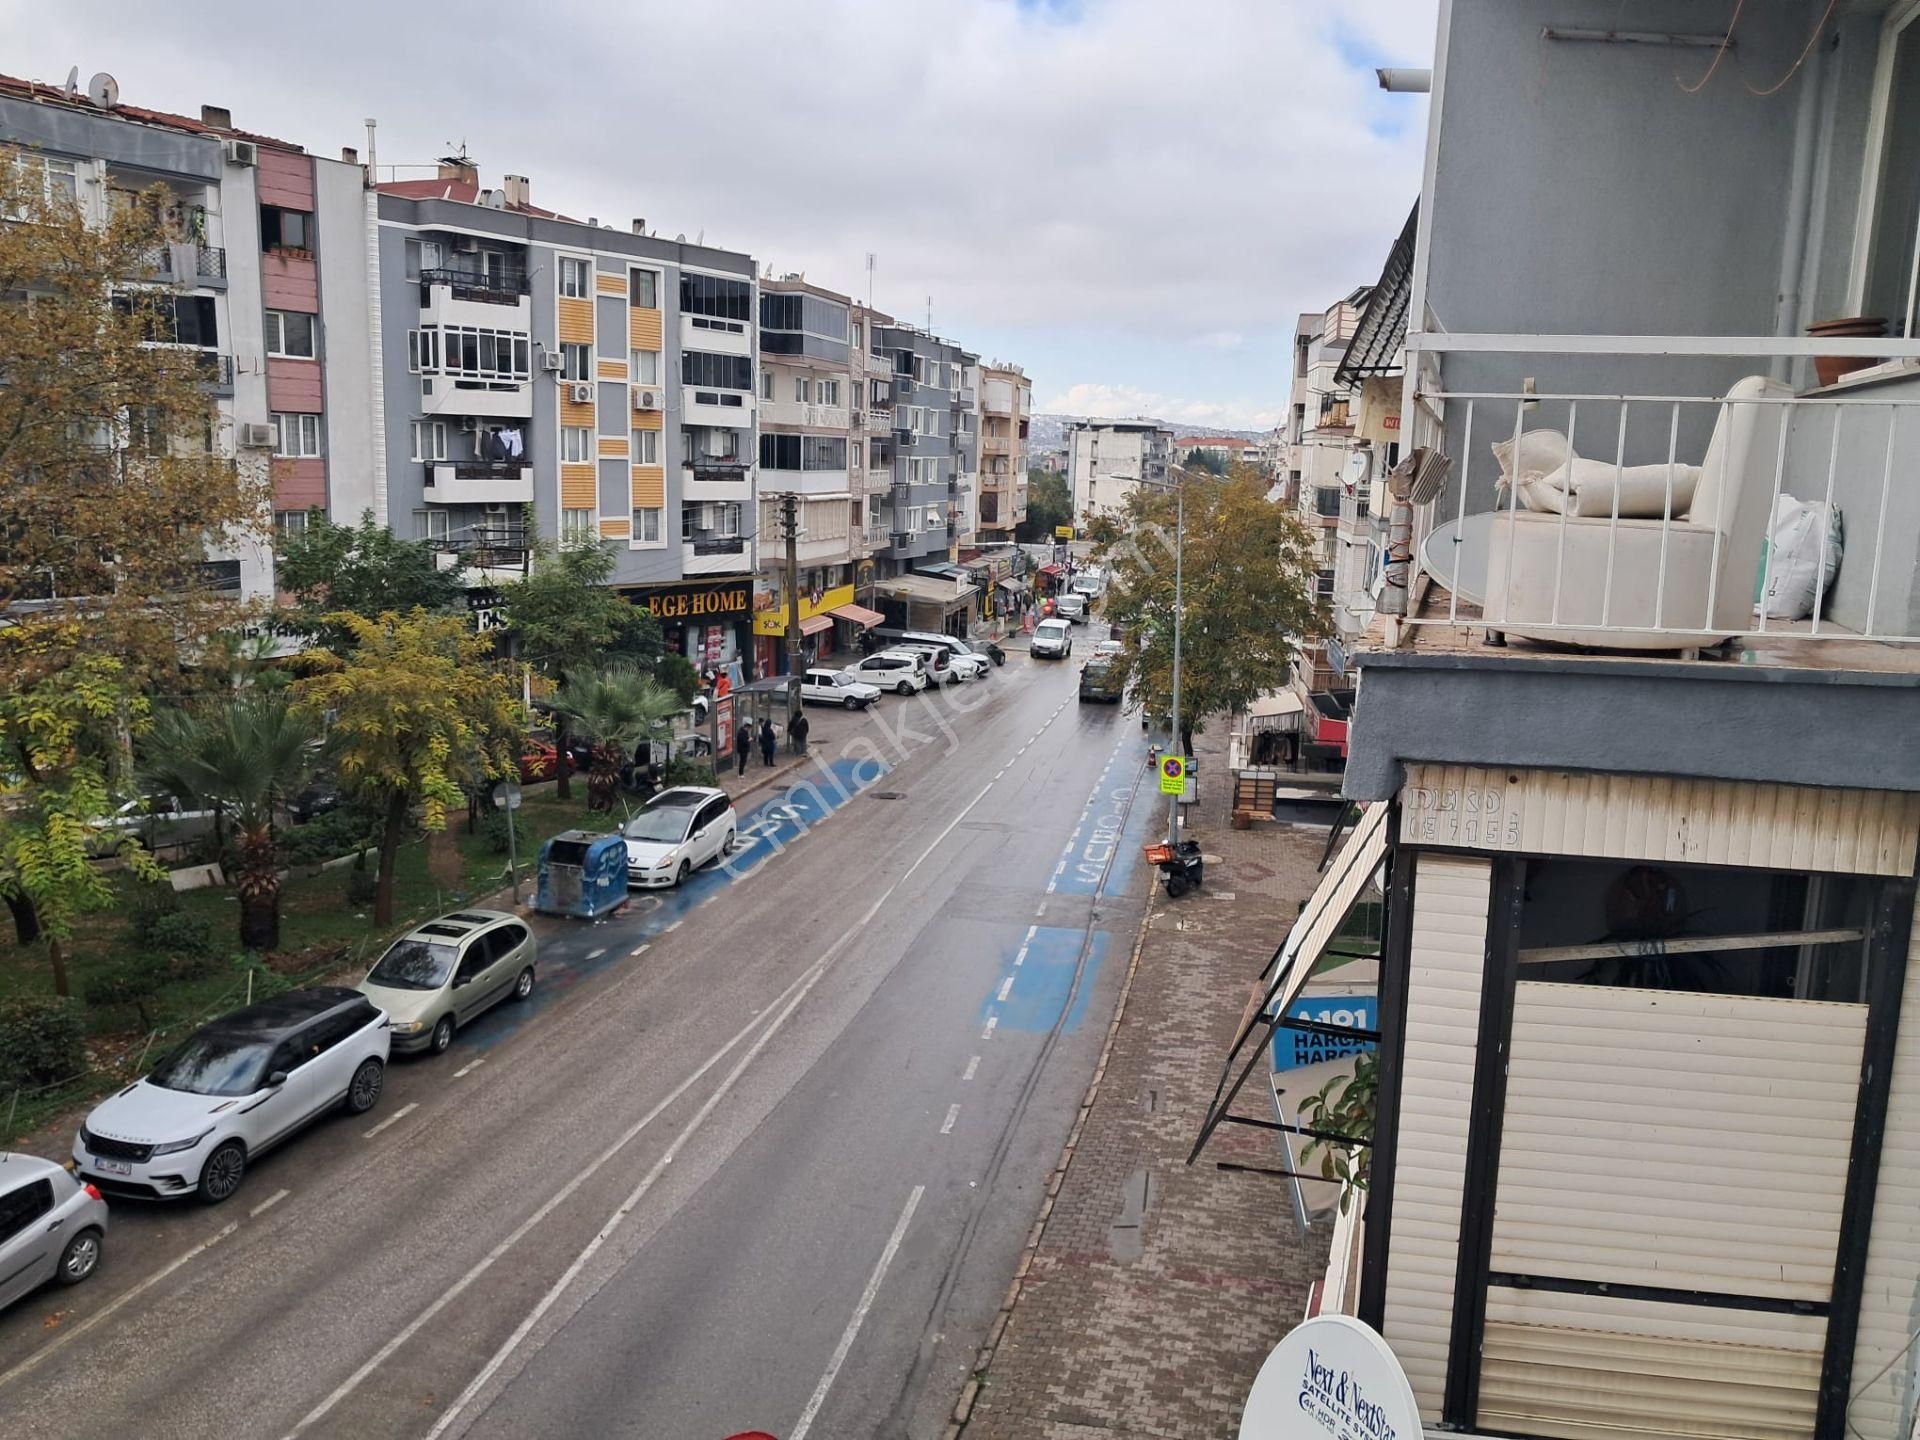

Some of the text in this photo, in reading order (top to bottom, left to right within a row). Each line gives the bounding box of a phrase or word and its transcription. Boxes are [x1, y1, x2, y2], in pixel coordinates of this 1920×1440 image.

[649, 590, 747, 617] EGE HOME
[1304, 1348, 1335, 1396] Next
[1336, 1371, 1349, 1406] &
[1302, 1379, 1352, 1426] SATELLITE
[1317, 1408, 1336, 1428] HDR
